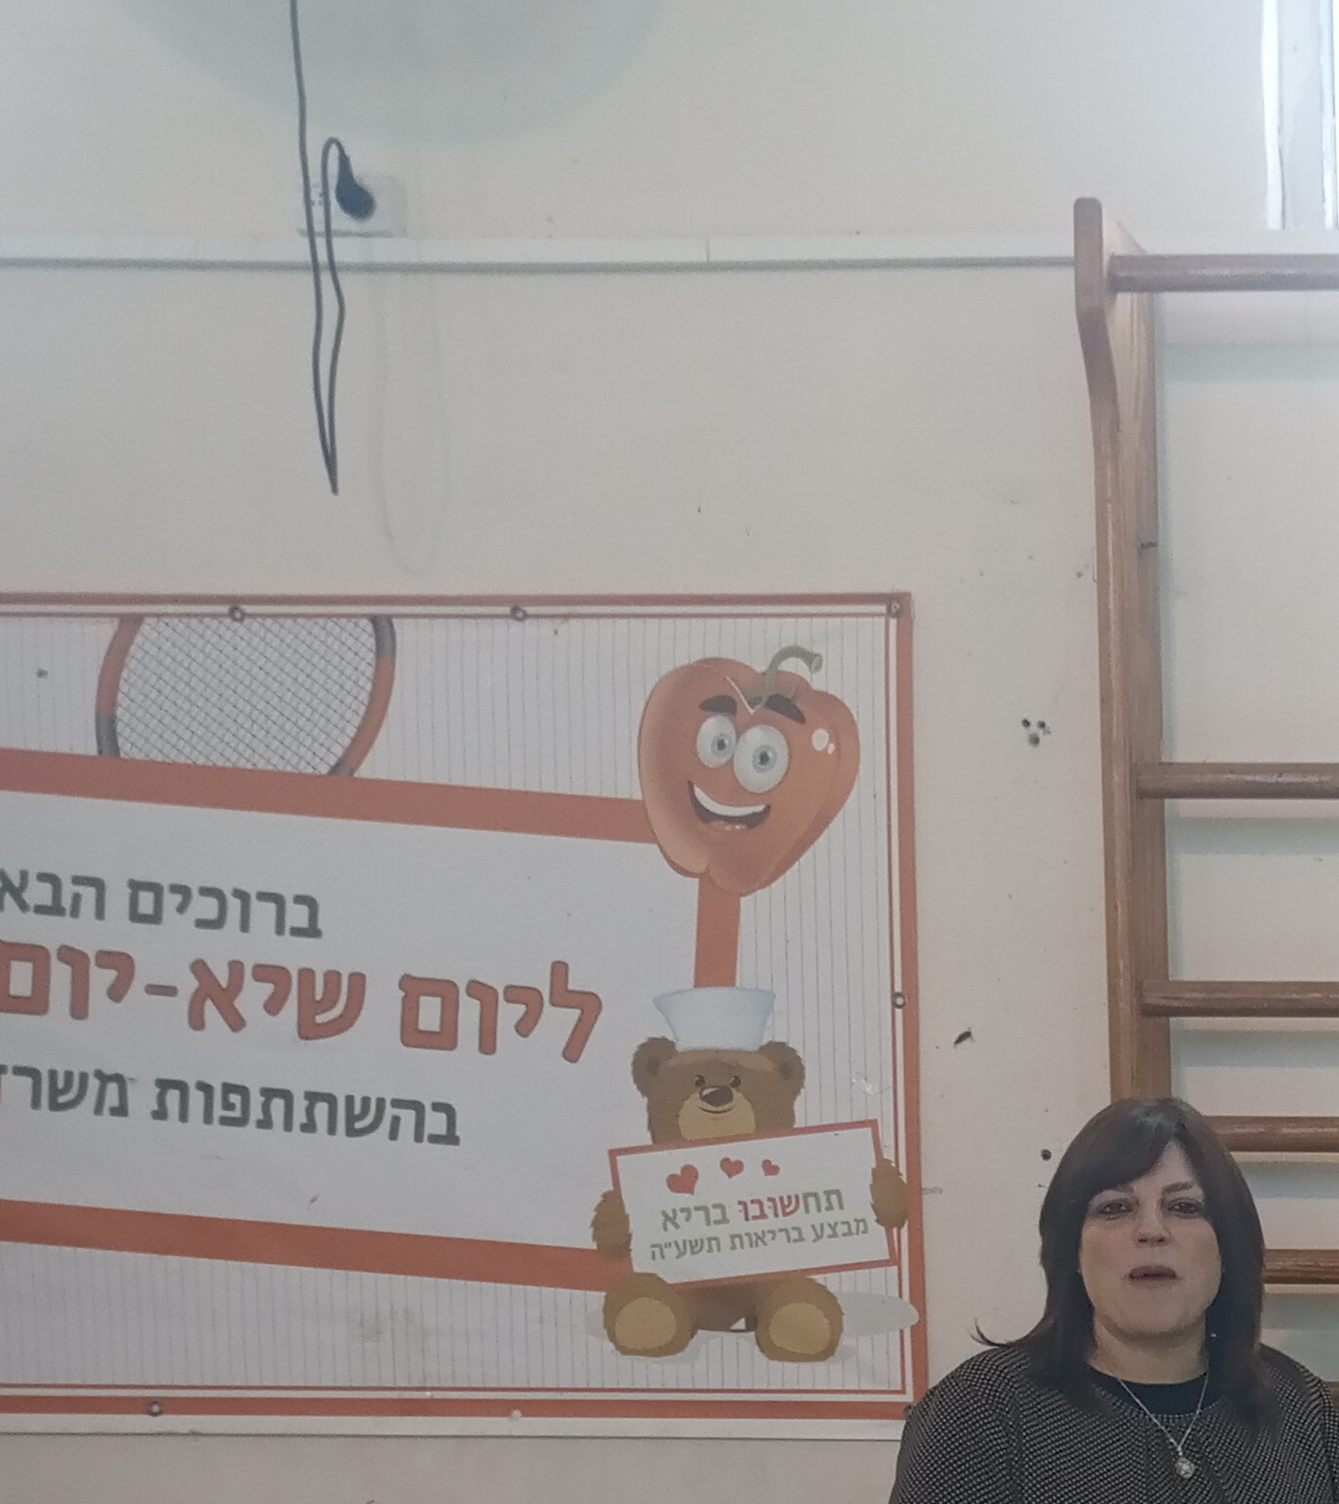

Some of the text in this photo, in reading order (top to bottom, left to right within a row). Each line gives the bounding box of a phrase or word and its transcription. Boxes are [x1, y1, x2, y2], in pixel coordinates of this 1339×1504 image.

[127, 878, 323, 939] ברוכים
[398, 961, 603, 1064] ליום
[0, 1063, 460, 1147] בהשתתפות משר
[660, 1203, 731, 1232] בריא
[729, 1226, 805, 1251] בריאות
[811, 1217, 869, 1244] מבצע
